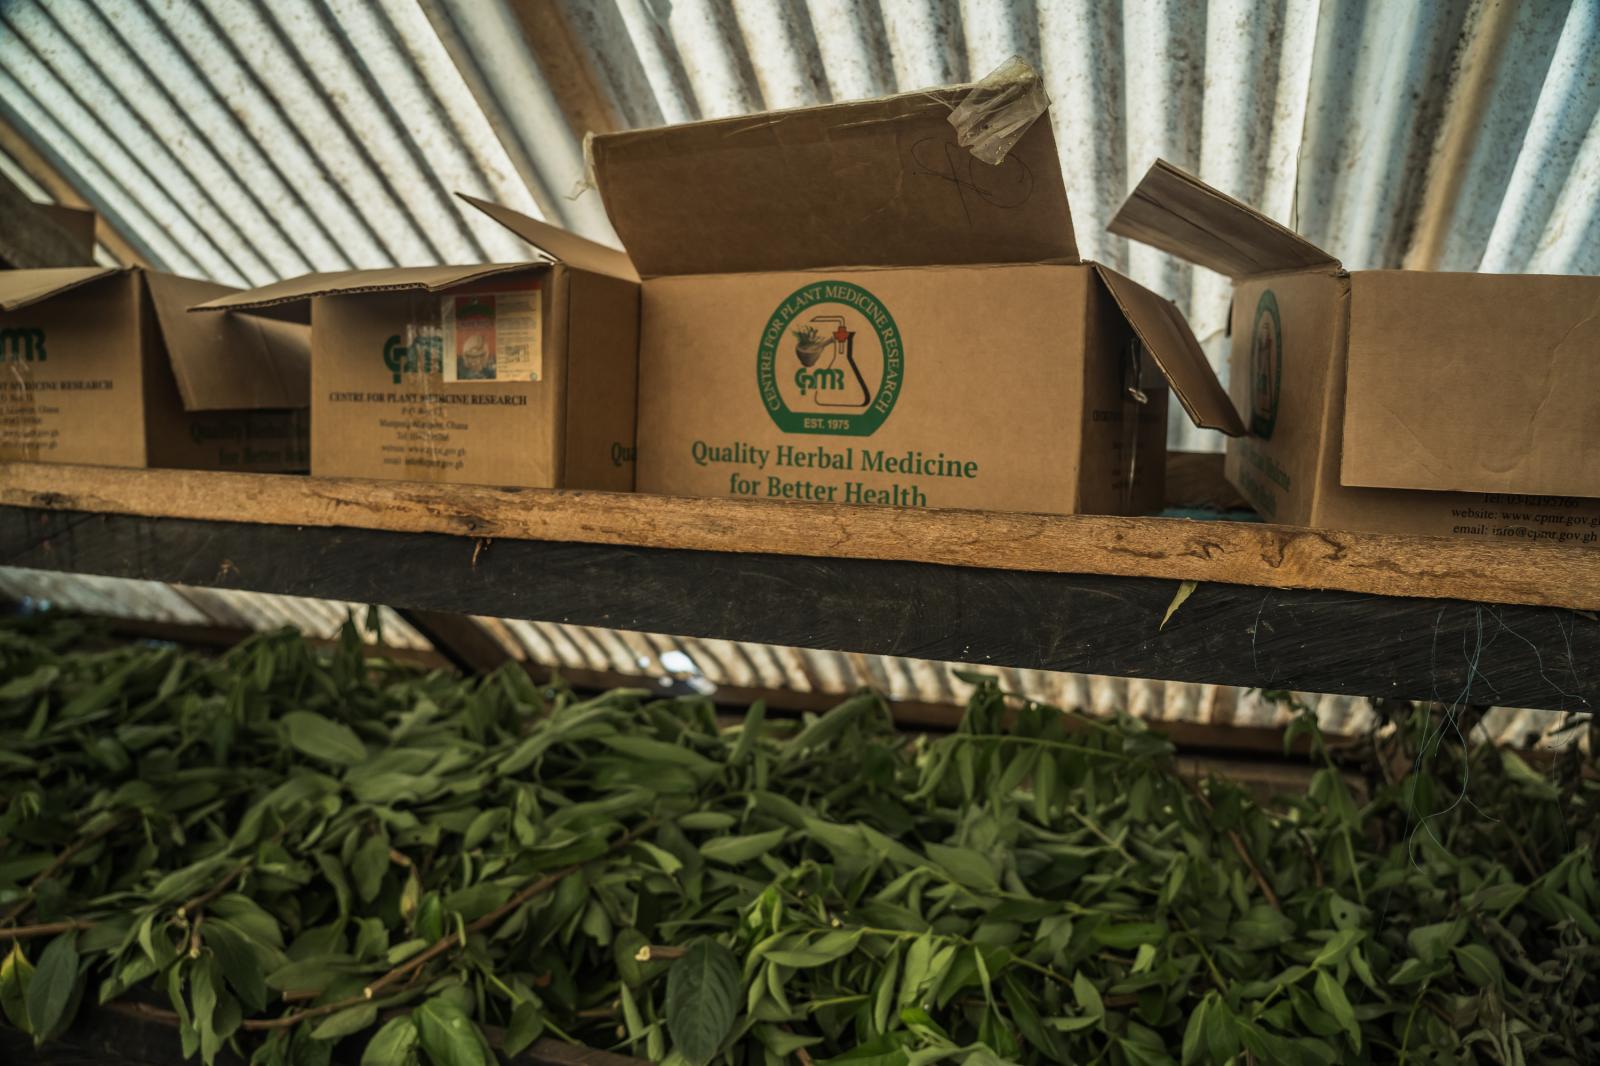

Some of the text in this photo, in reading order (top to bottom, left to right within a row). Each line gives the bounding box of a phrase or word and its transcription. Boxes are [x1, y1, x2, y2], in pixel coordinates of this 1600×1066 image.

[761, 284, 900, 414] CENTRE FOR PLANT MEDICINE RESEARCH
[329, 391, 364, 403] CENTRE
[366, 392, 385, 403] FOR
[387, 392, 418, 404] PLANT
[471, 394, 527, 406] RESEARCH
[803, 418, 850, 430] EST. 1975
[611, 441, 637, 467] Qua
[691, 440, 979, 479] Quality Herbal Medicine
[729, 473, 927, 507] for Better Health
[1451, 507, 1499, 520] website:
[1452, 524, 1597, 543] email: info@cpmr.gov.gh
